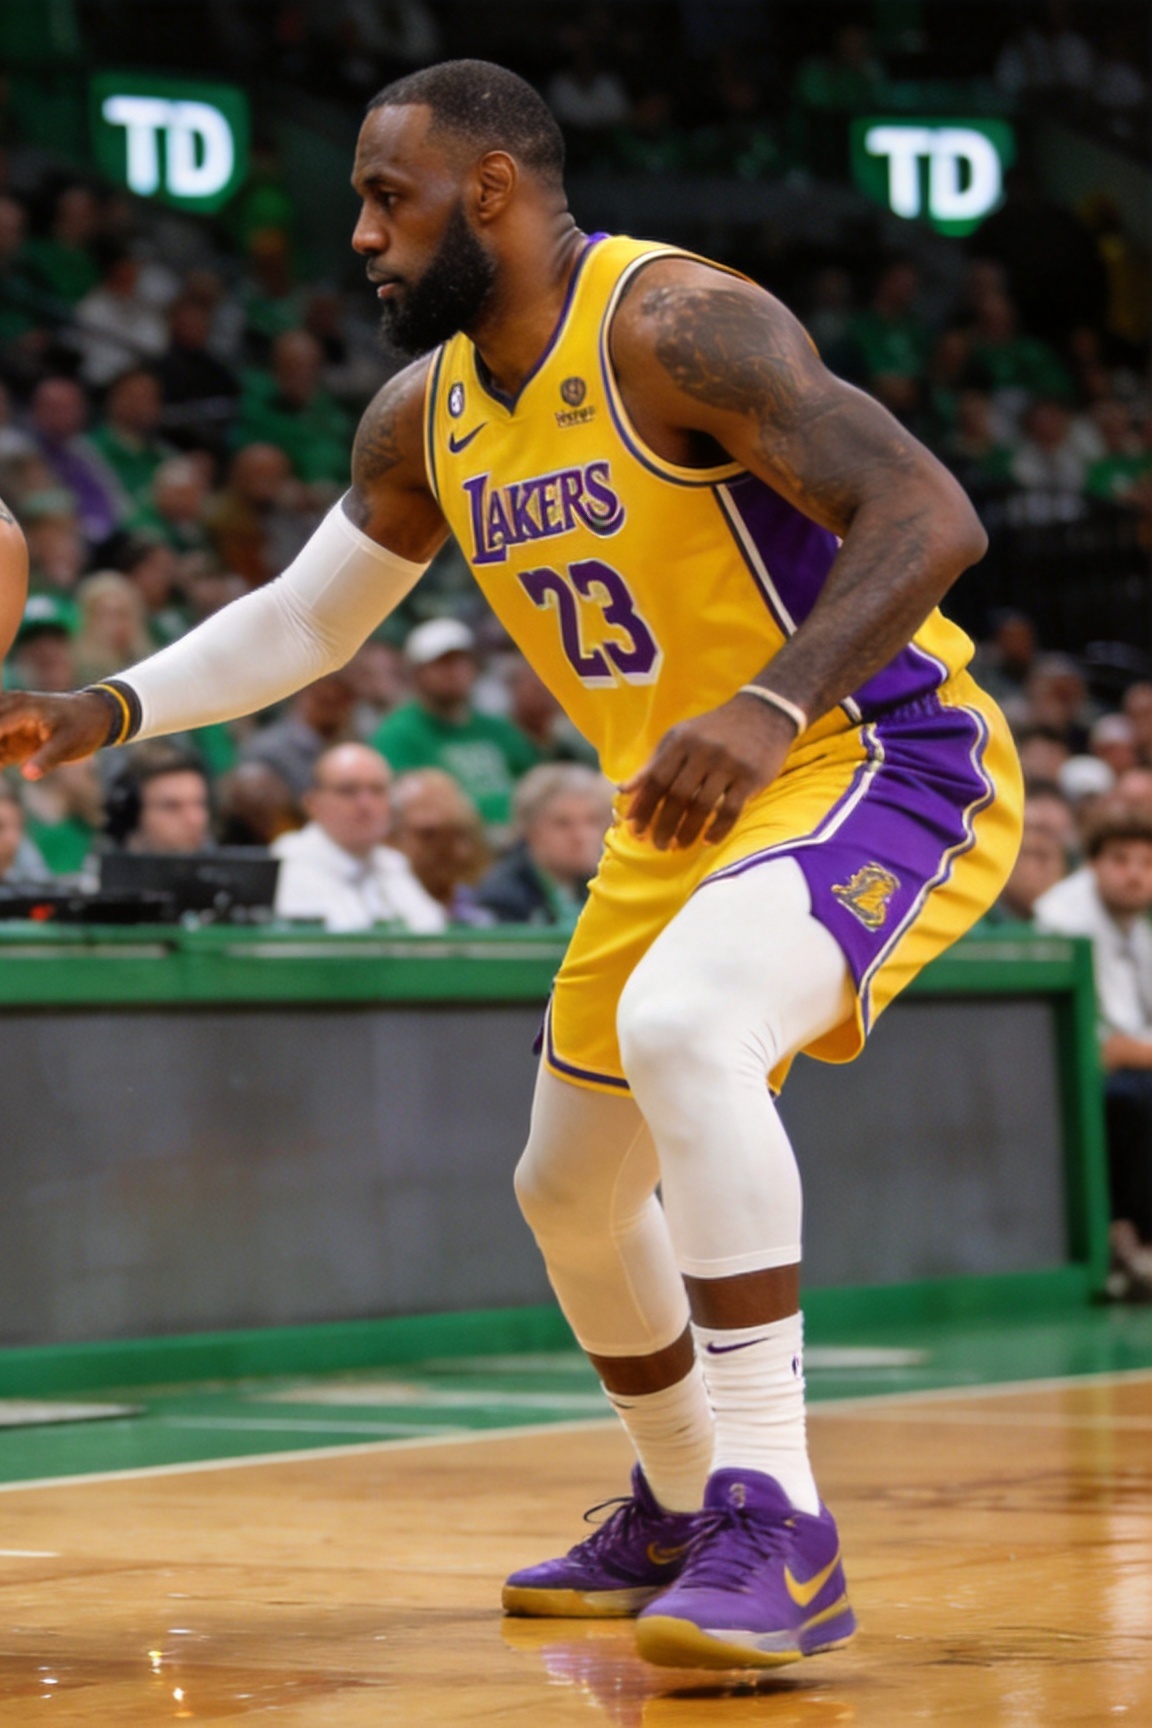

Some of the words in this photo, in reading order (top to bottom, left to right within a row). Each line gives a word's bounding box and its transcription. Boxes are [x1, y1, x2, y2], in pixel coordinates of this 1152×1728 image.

[102, 94, 235, 198] TD
[865, 125, 1002, 220] TD
[462, 460, 626, 567] LAKERS
[517, 558, 664, 689] 23
